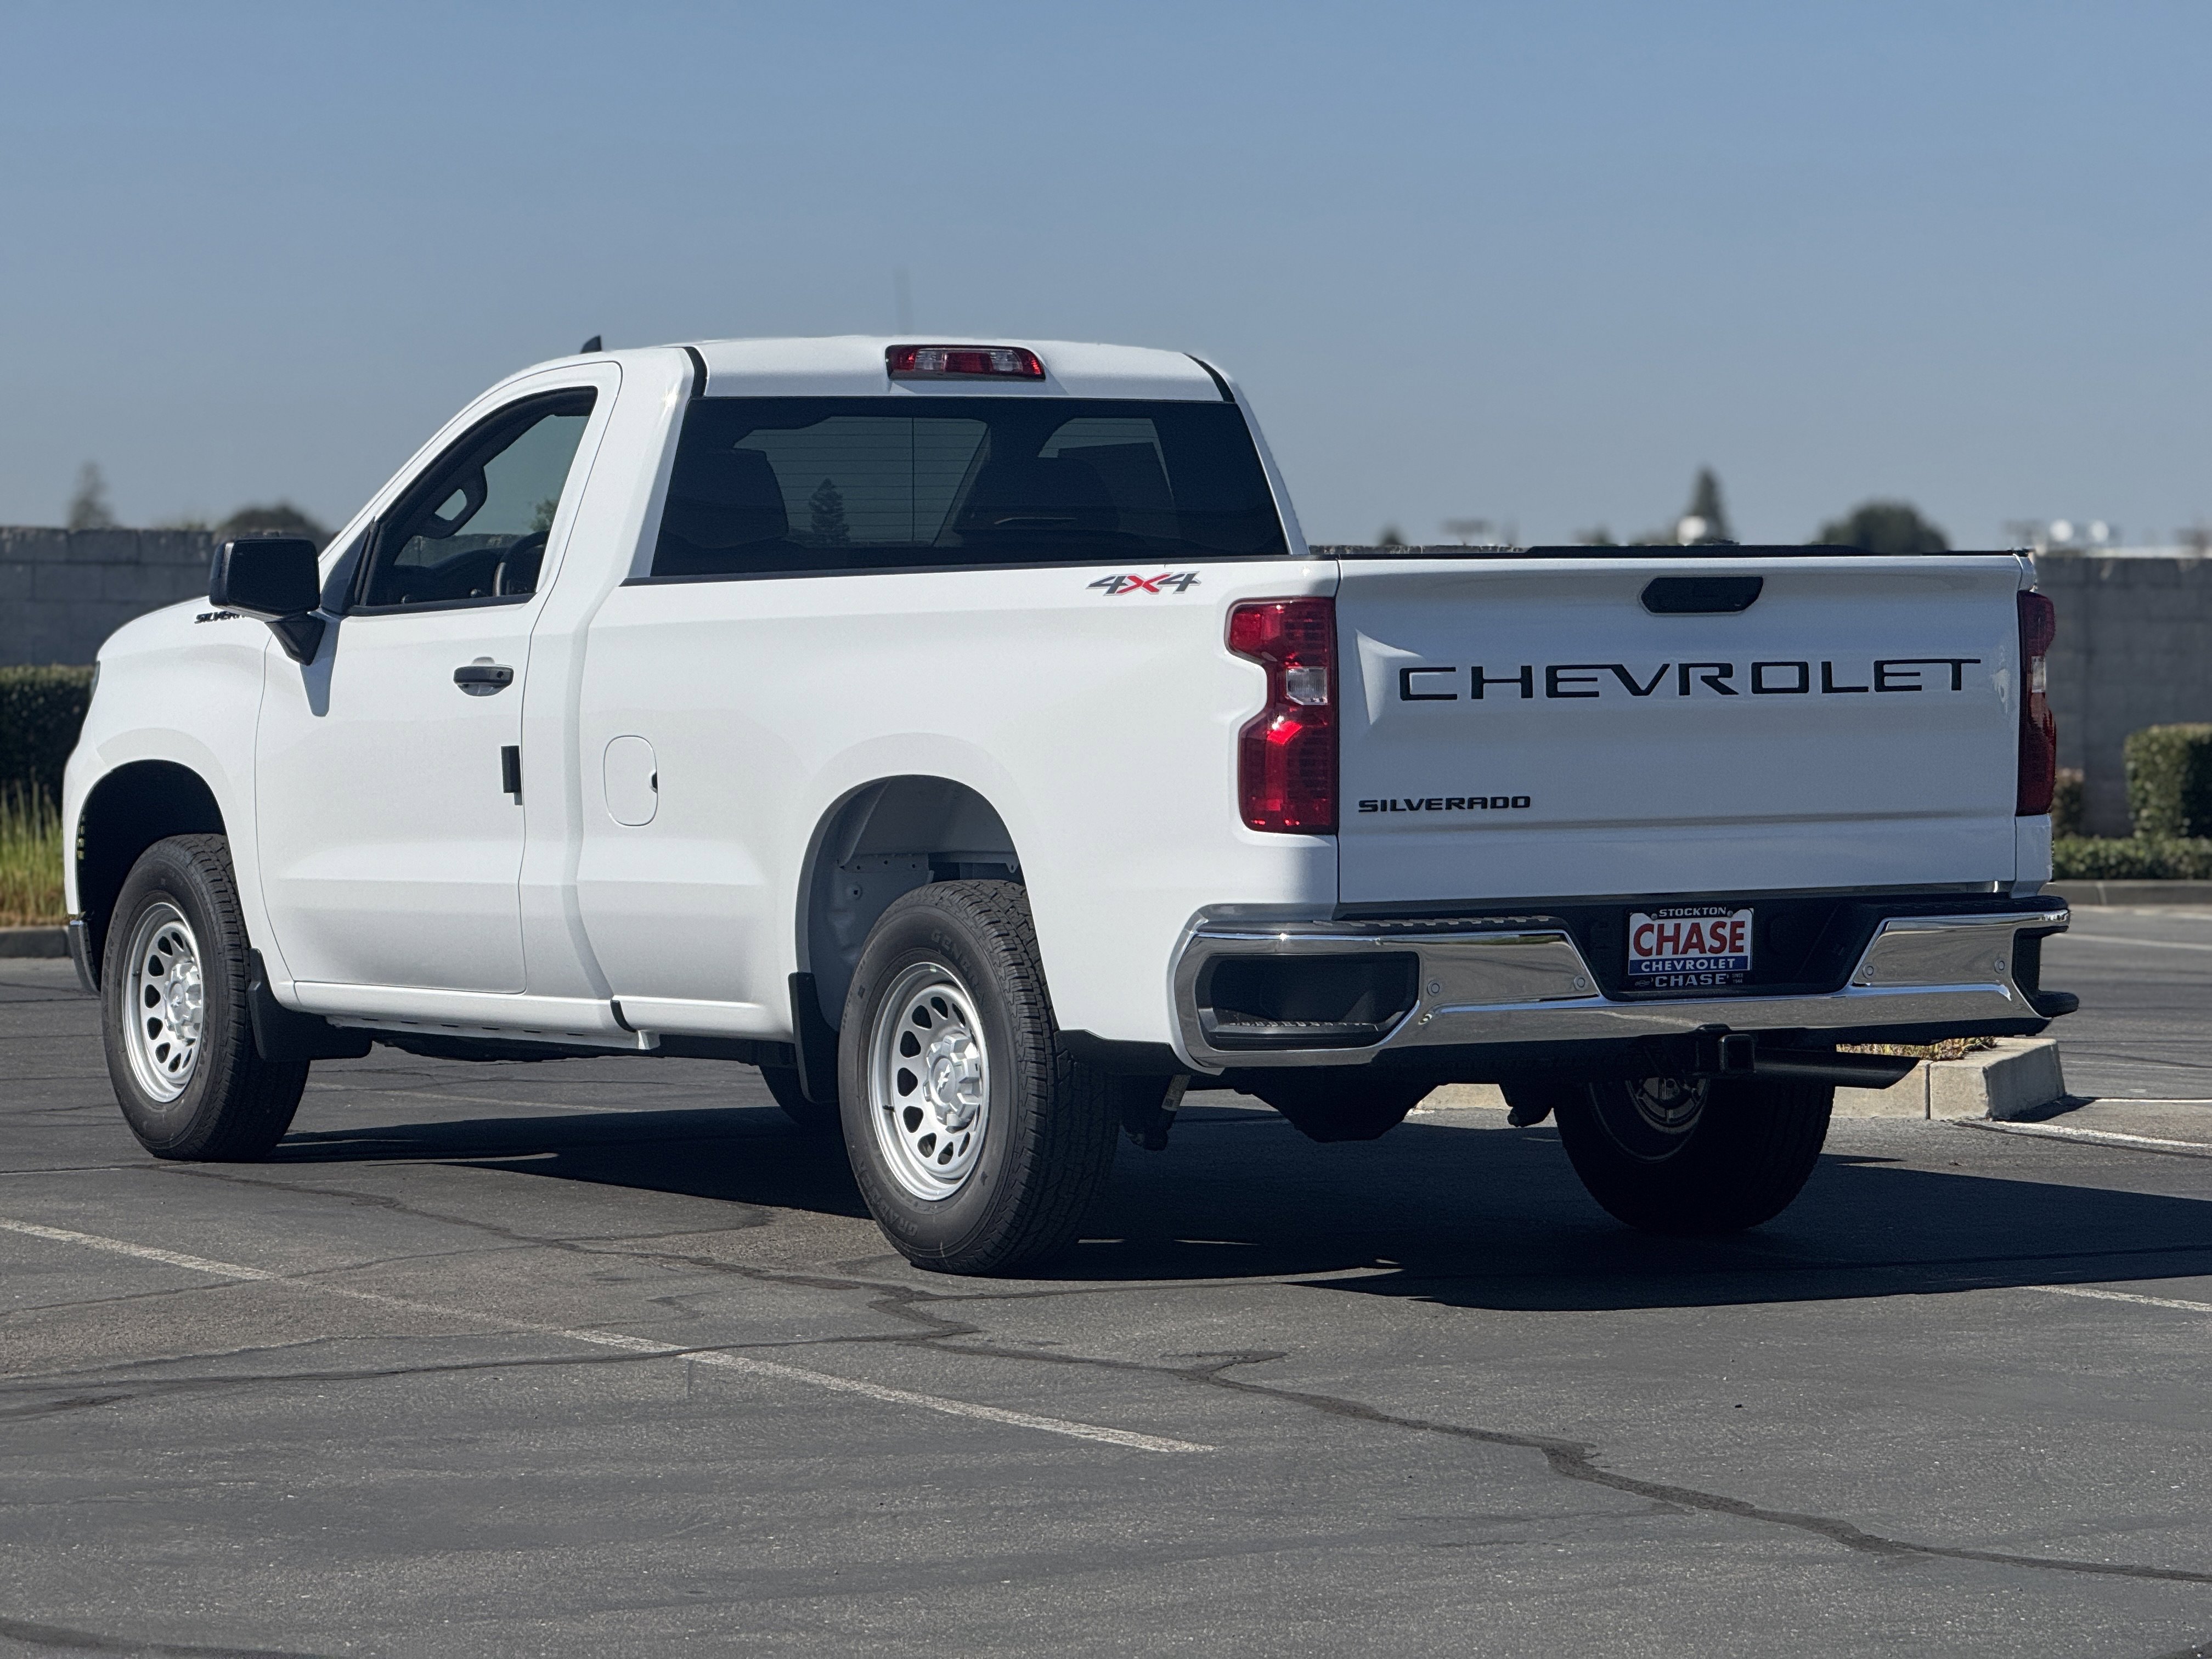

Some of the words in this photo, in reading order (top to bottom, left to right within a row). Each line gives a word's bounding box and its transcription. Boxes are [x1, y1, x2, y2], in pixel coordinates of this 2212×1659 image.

[1399, 658, 1981, 702] CHEVROLET
[1358, 796, 1531, 812] SILVERADO
[1658, 907, 1726, 917] STOCKTON
[1633, 921, 1745, 957] CHASE
[1641, 958, 1735, 972] CHEVROLET
